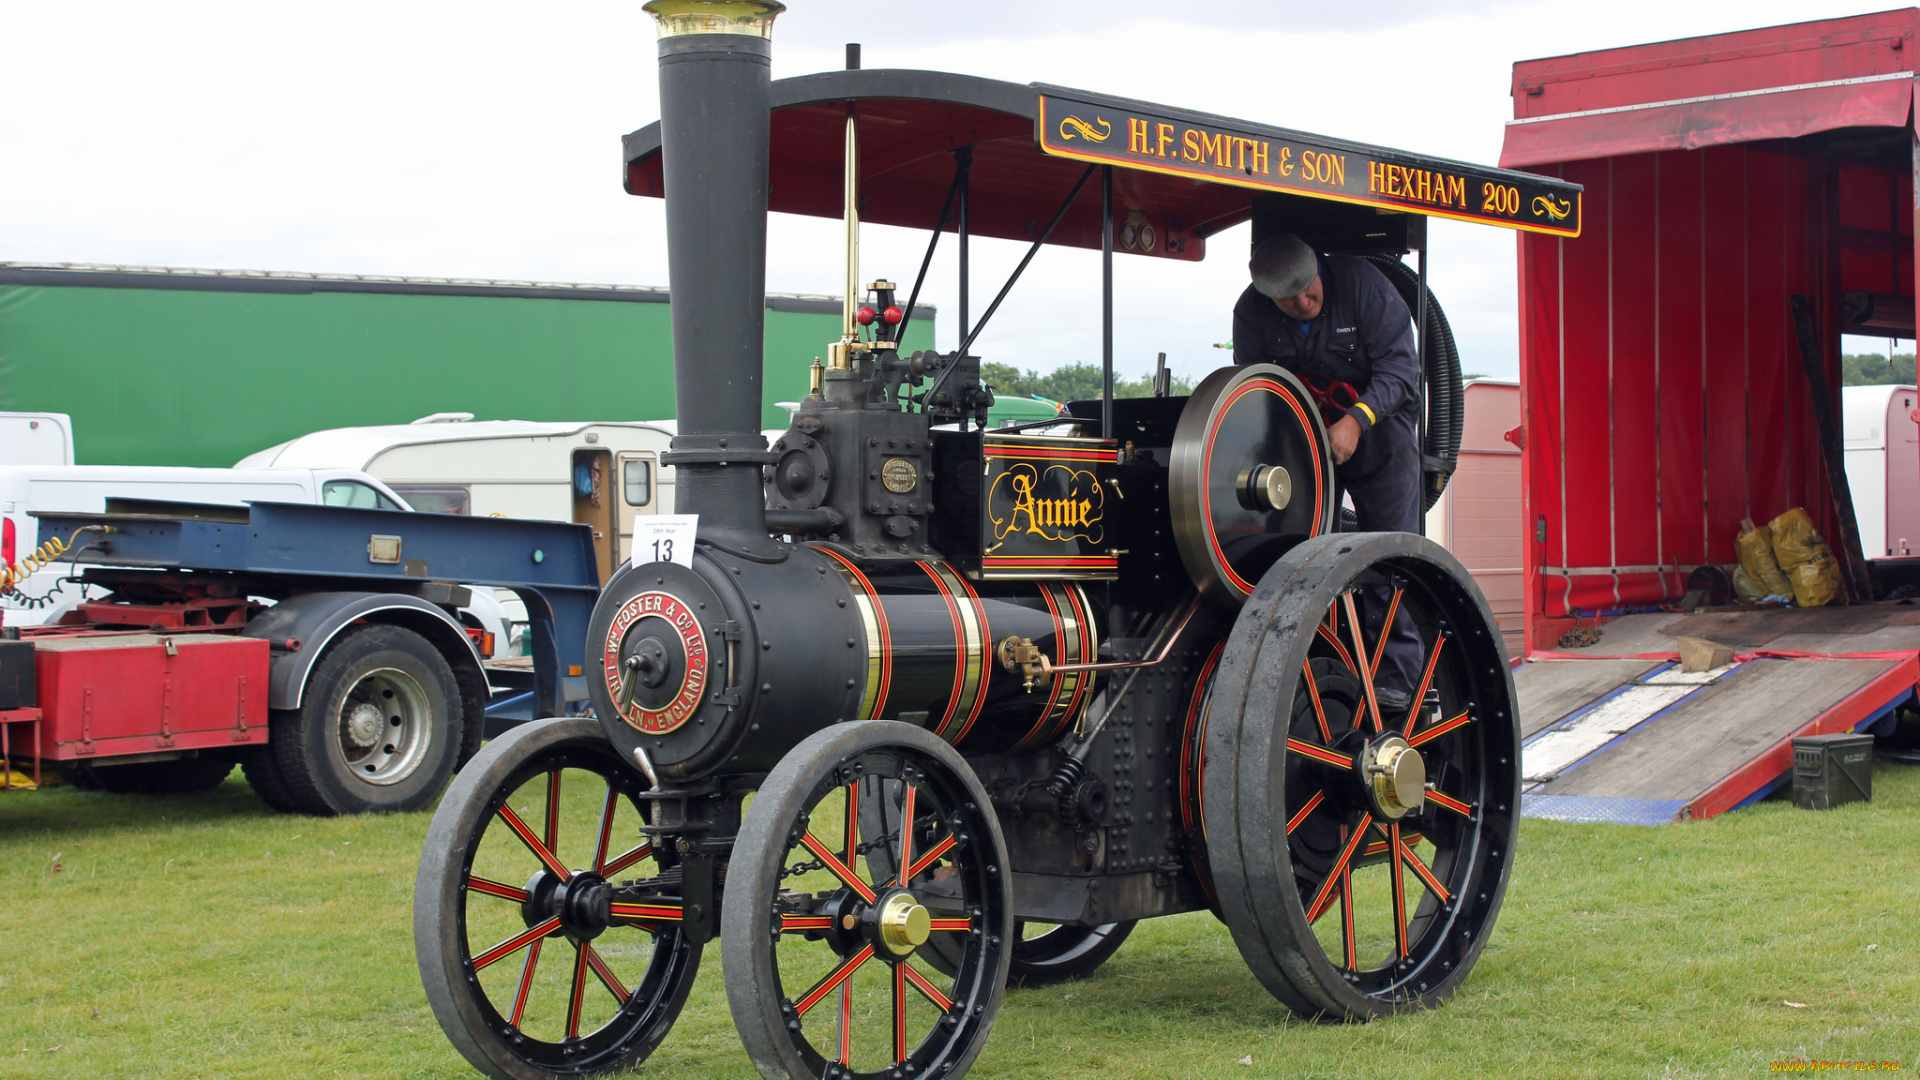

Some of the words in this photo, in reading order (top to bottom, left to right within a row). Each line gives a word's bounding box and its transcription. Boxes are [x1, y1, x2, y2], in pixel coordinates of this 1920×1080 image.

[1128, 117, 1177, 158] H.F.
[1182, 128, 1270, 175] SMITH
[1279, 146, 1295, 177] &
[1301, 150, 1345, 186] SON
[1369, 160, 1467, 208] HEXHAM
[1482, 181, 1520, 215] 200
[1005, 473, 1093, 537] Annie
[652, 539, 673, 562] 13
[616, 596, 662, 630] FOSTER
[666, 602, 676, 617] &
